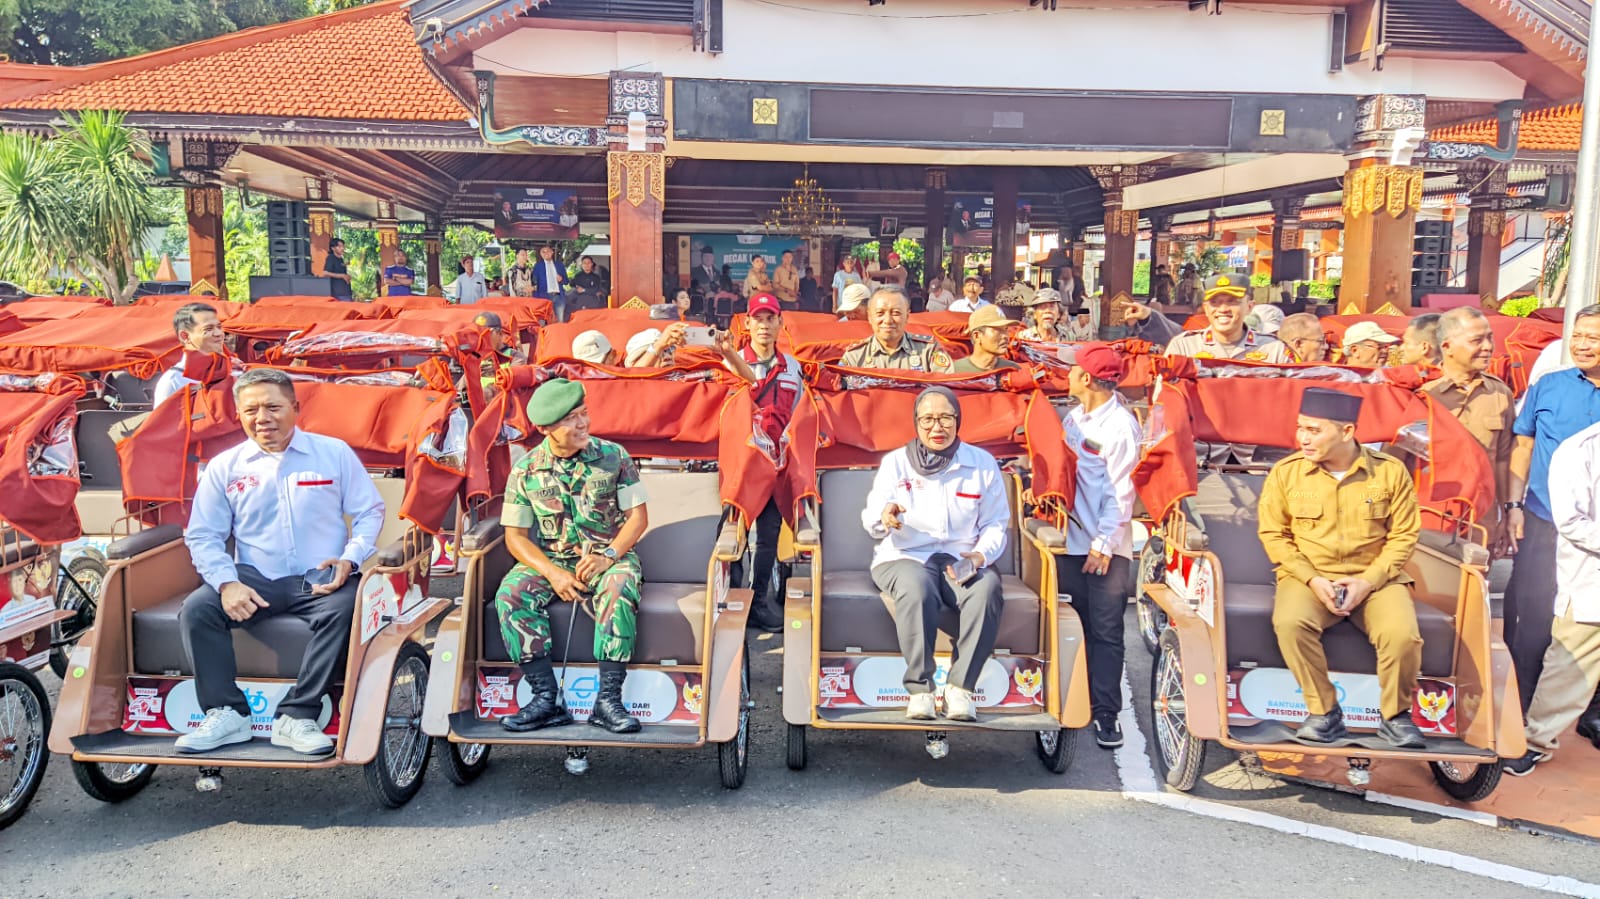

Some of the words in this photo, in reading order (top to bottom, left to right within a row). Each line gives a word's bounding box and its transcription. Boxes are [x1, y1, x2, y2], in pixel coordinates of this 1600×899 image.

[723, 254, 748, 264] BECAK
[1267, 700, 1306, 709] BANTUAN
[1266, 708, 1303, 717] PRESIDEN
[1347, 714, 1381, 722] SUBIANT
